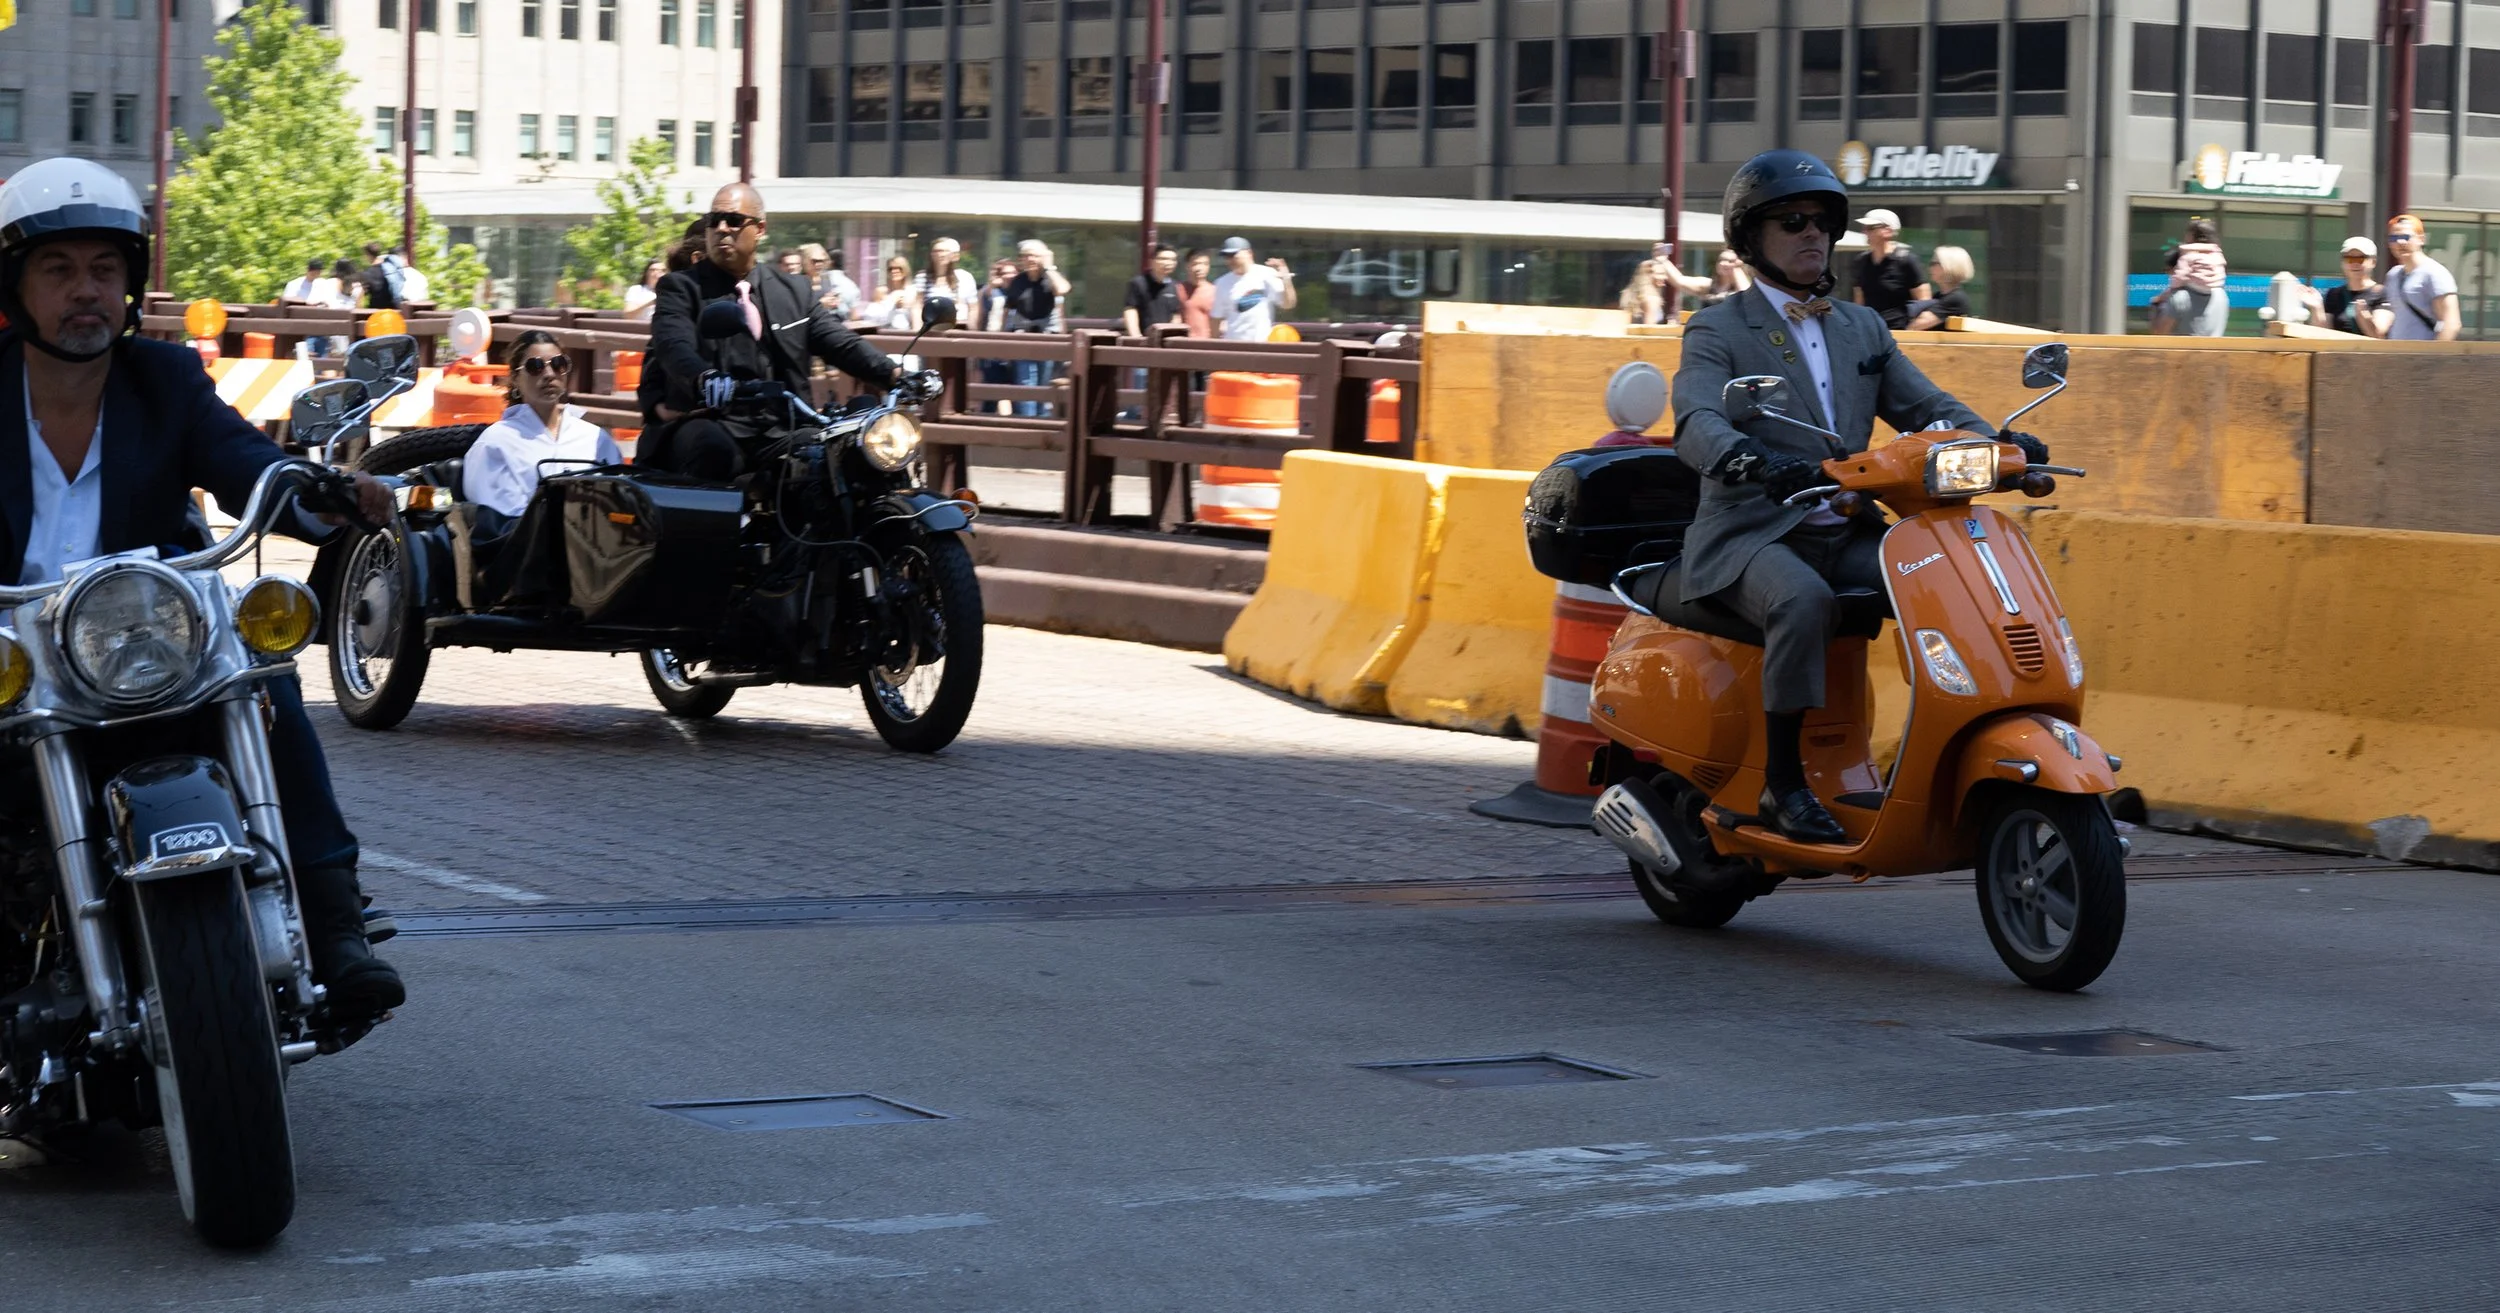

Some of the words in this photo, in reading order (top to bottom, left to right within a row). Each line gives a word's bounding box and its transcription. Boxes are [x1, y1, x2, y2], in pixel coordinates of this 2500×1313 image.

[1869, 145, 1999, 186] Fidelity
[2226, 151, 2344, 197] Fidelity
[160, 828, 218, 851] 1200
